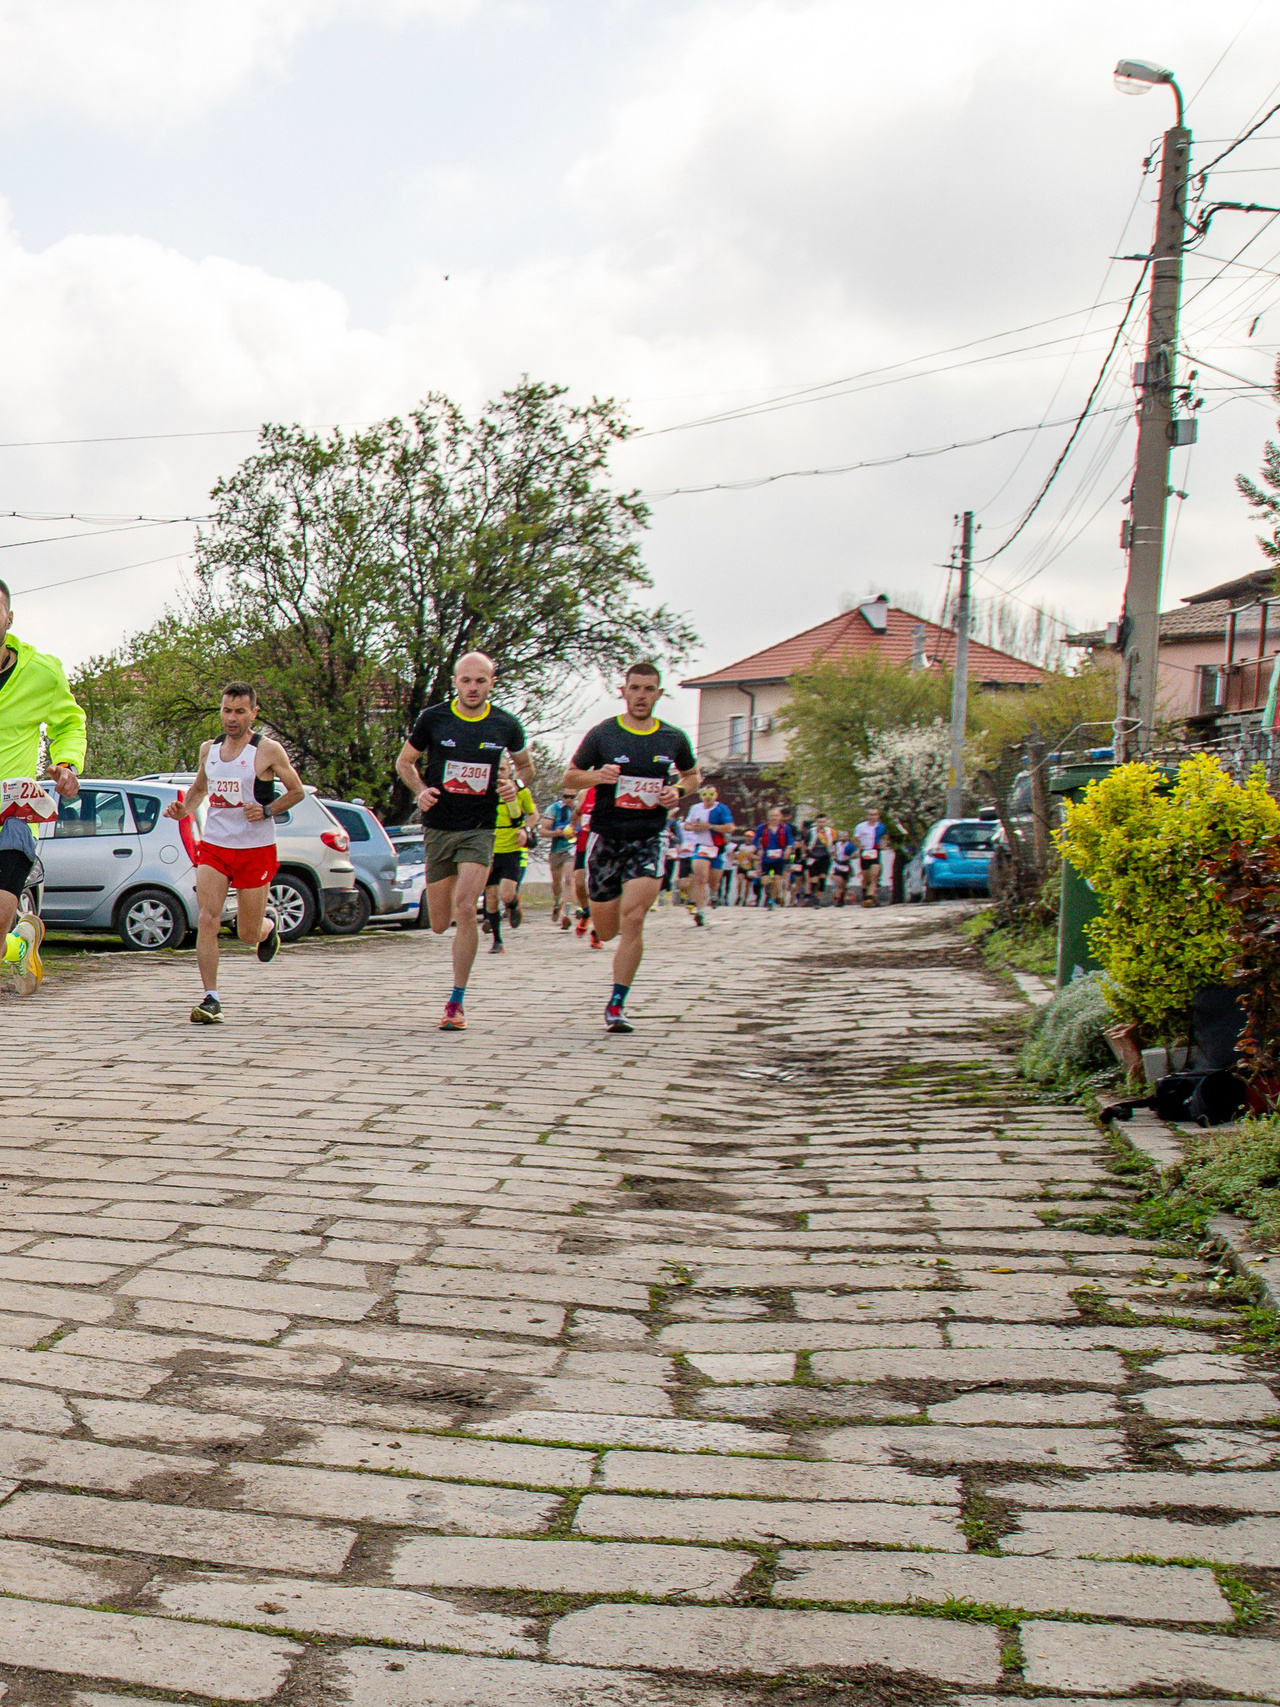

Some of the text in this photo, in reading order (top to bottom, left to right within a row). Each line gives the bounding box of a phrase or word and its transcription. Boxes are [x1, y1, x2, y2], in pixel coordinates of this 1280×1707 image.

[460, 766, 488, 779] 2304
[217, 781, 240, 793] 2373
[634, 780, 660, 793] 2435
